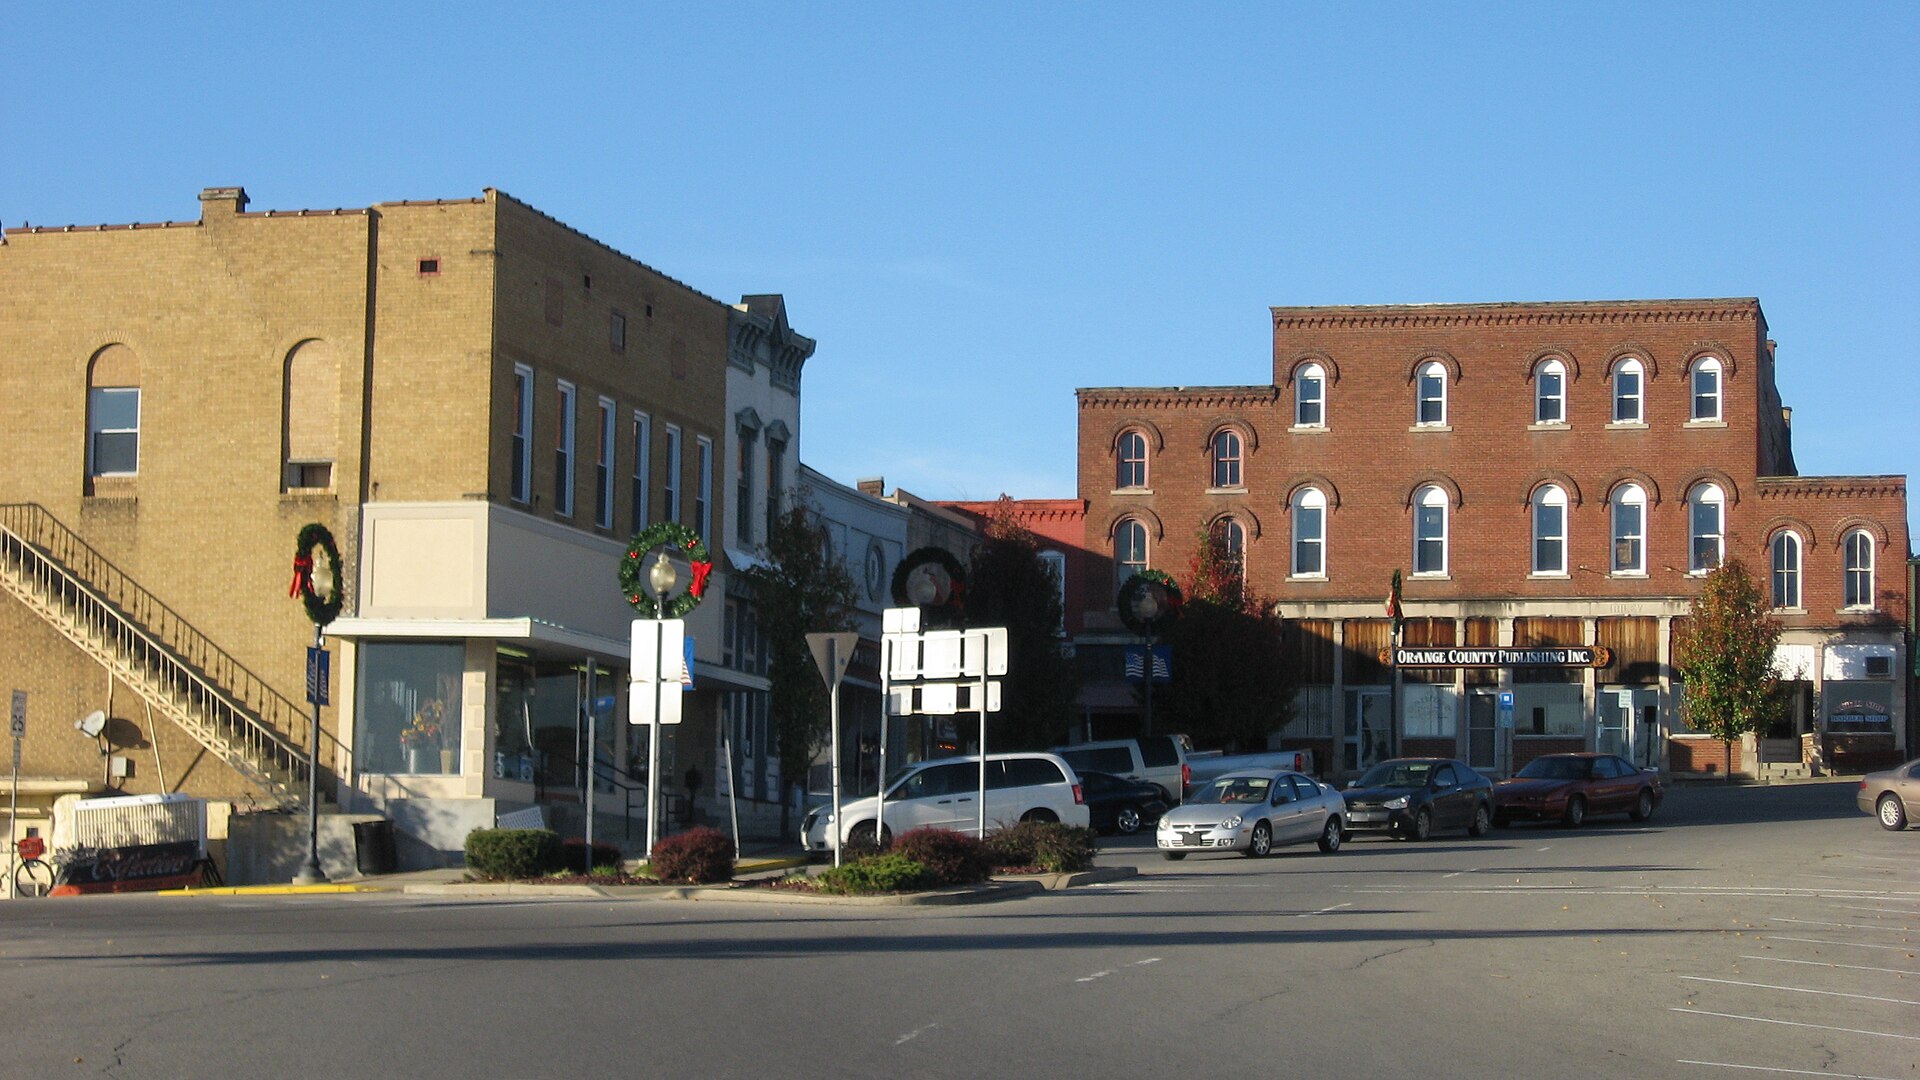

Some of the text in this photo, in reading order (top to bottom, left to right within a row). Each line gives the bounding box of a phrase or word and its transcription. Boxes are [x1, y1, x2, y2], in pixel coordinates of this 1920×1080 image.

[1397, 650, 1590, 664] ORANGE COUNTY PUBLISHING INC.
[12, 715, 24, 732] 25
